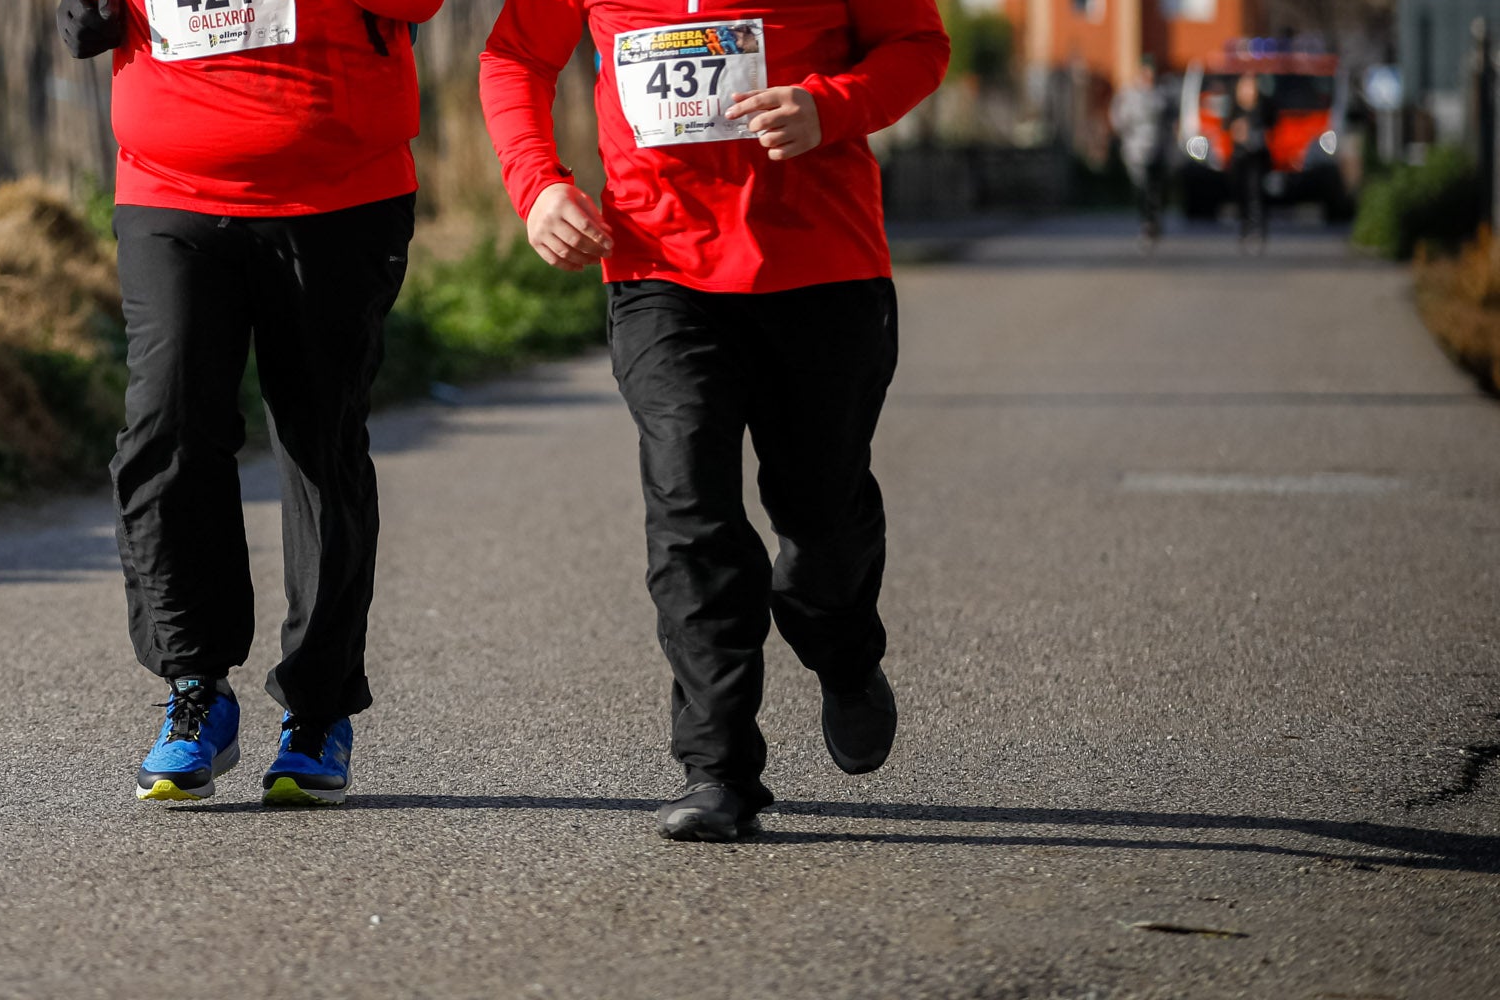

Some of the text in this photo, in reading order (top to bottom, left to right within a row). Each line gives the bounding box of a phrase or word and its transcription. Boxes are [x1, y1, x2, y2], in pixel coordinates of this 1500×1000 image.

[189, 8, 255, 32] @ALEXROD
[219, 30, 248, 40] olimpo
[651, 39, 704, 50] POPULAR
[646, 58, 726, 99] 437
[675, 101, 703, 117] JOSE
[685, 121, 715, 129] olimpo
